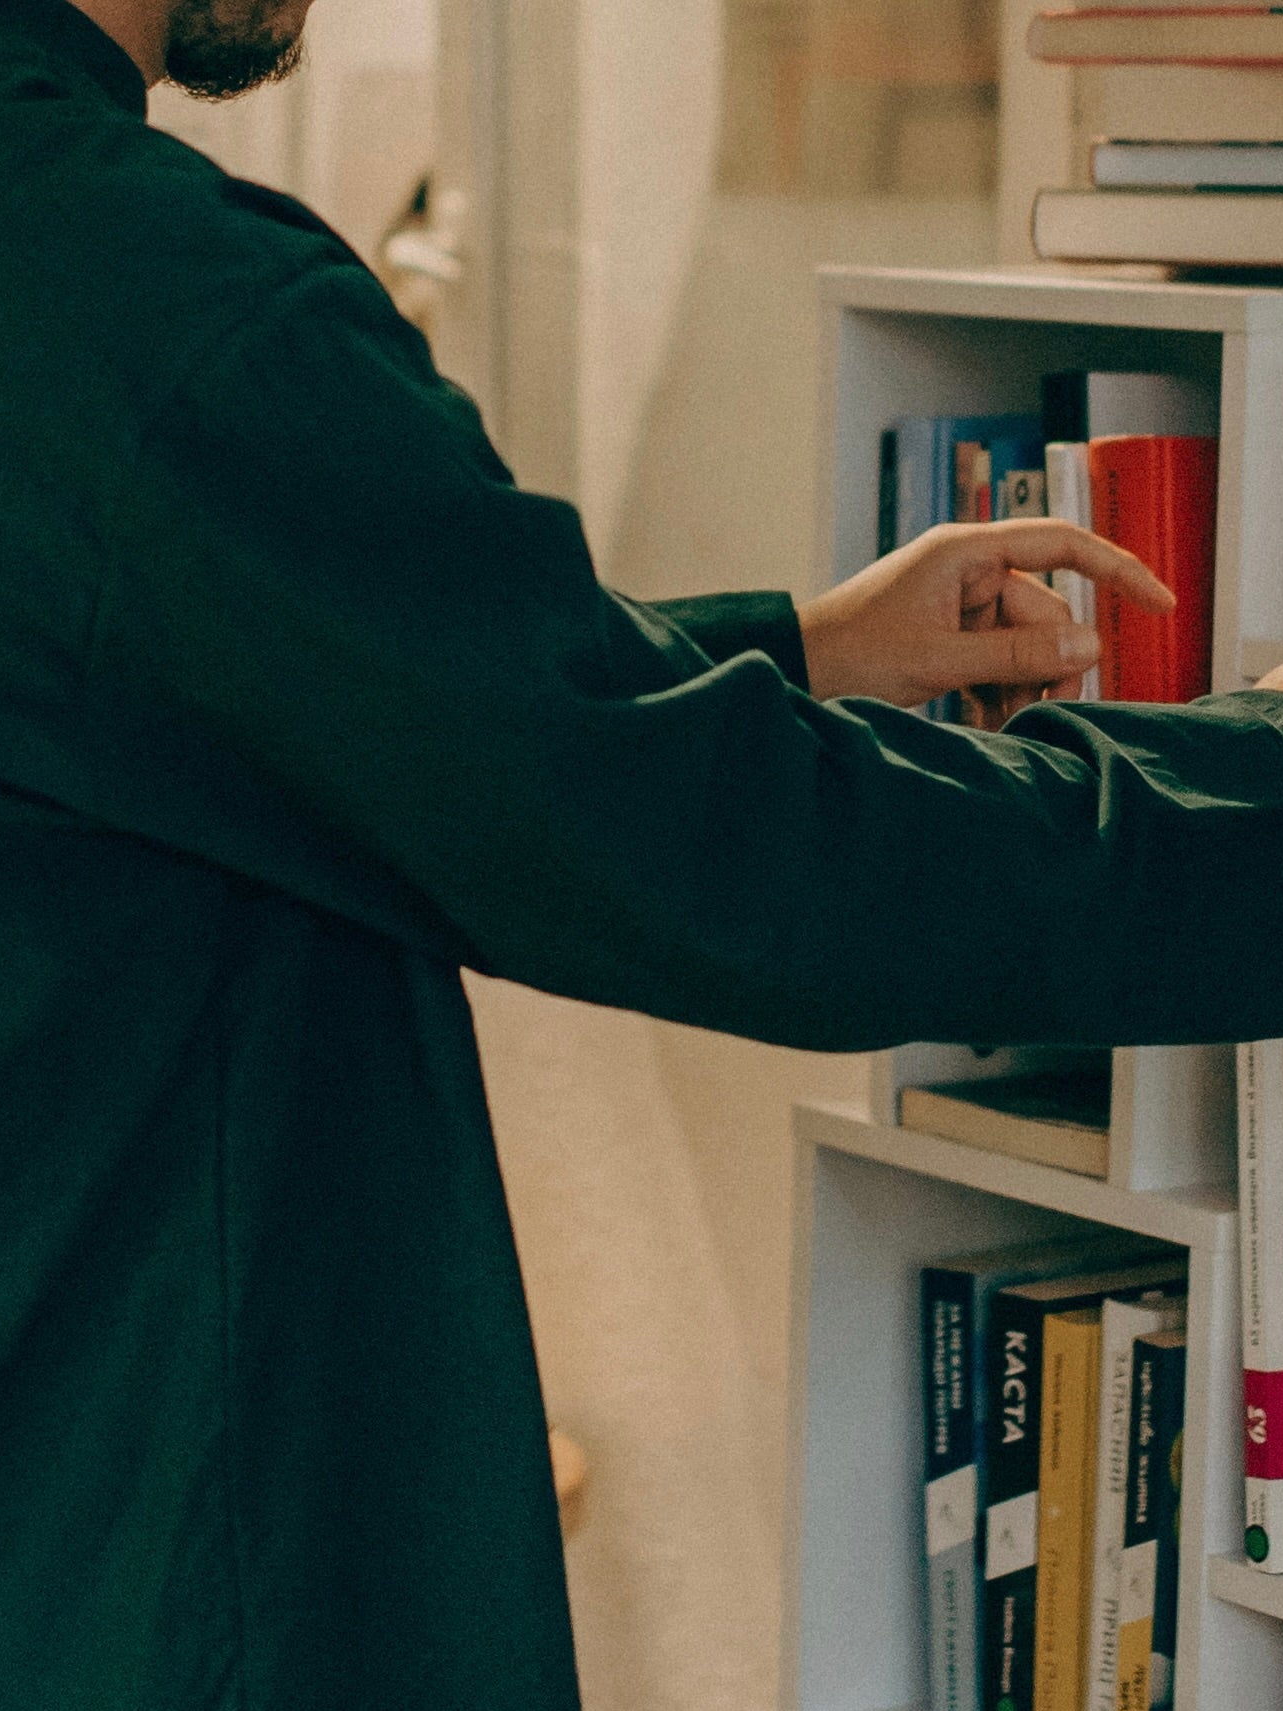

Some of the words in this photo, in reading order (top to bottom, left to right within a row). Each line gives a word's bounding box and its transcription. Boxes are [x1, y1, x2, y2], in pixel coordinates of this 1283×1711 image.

[1002, 1330, 1028, 1444] КАСТА
[1107, 1354, 1127, 1494] ЗАПАСНИЙ
[1098, 1598, 1118, 1684] ПРИНЦ
